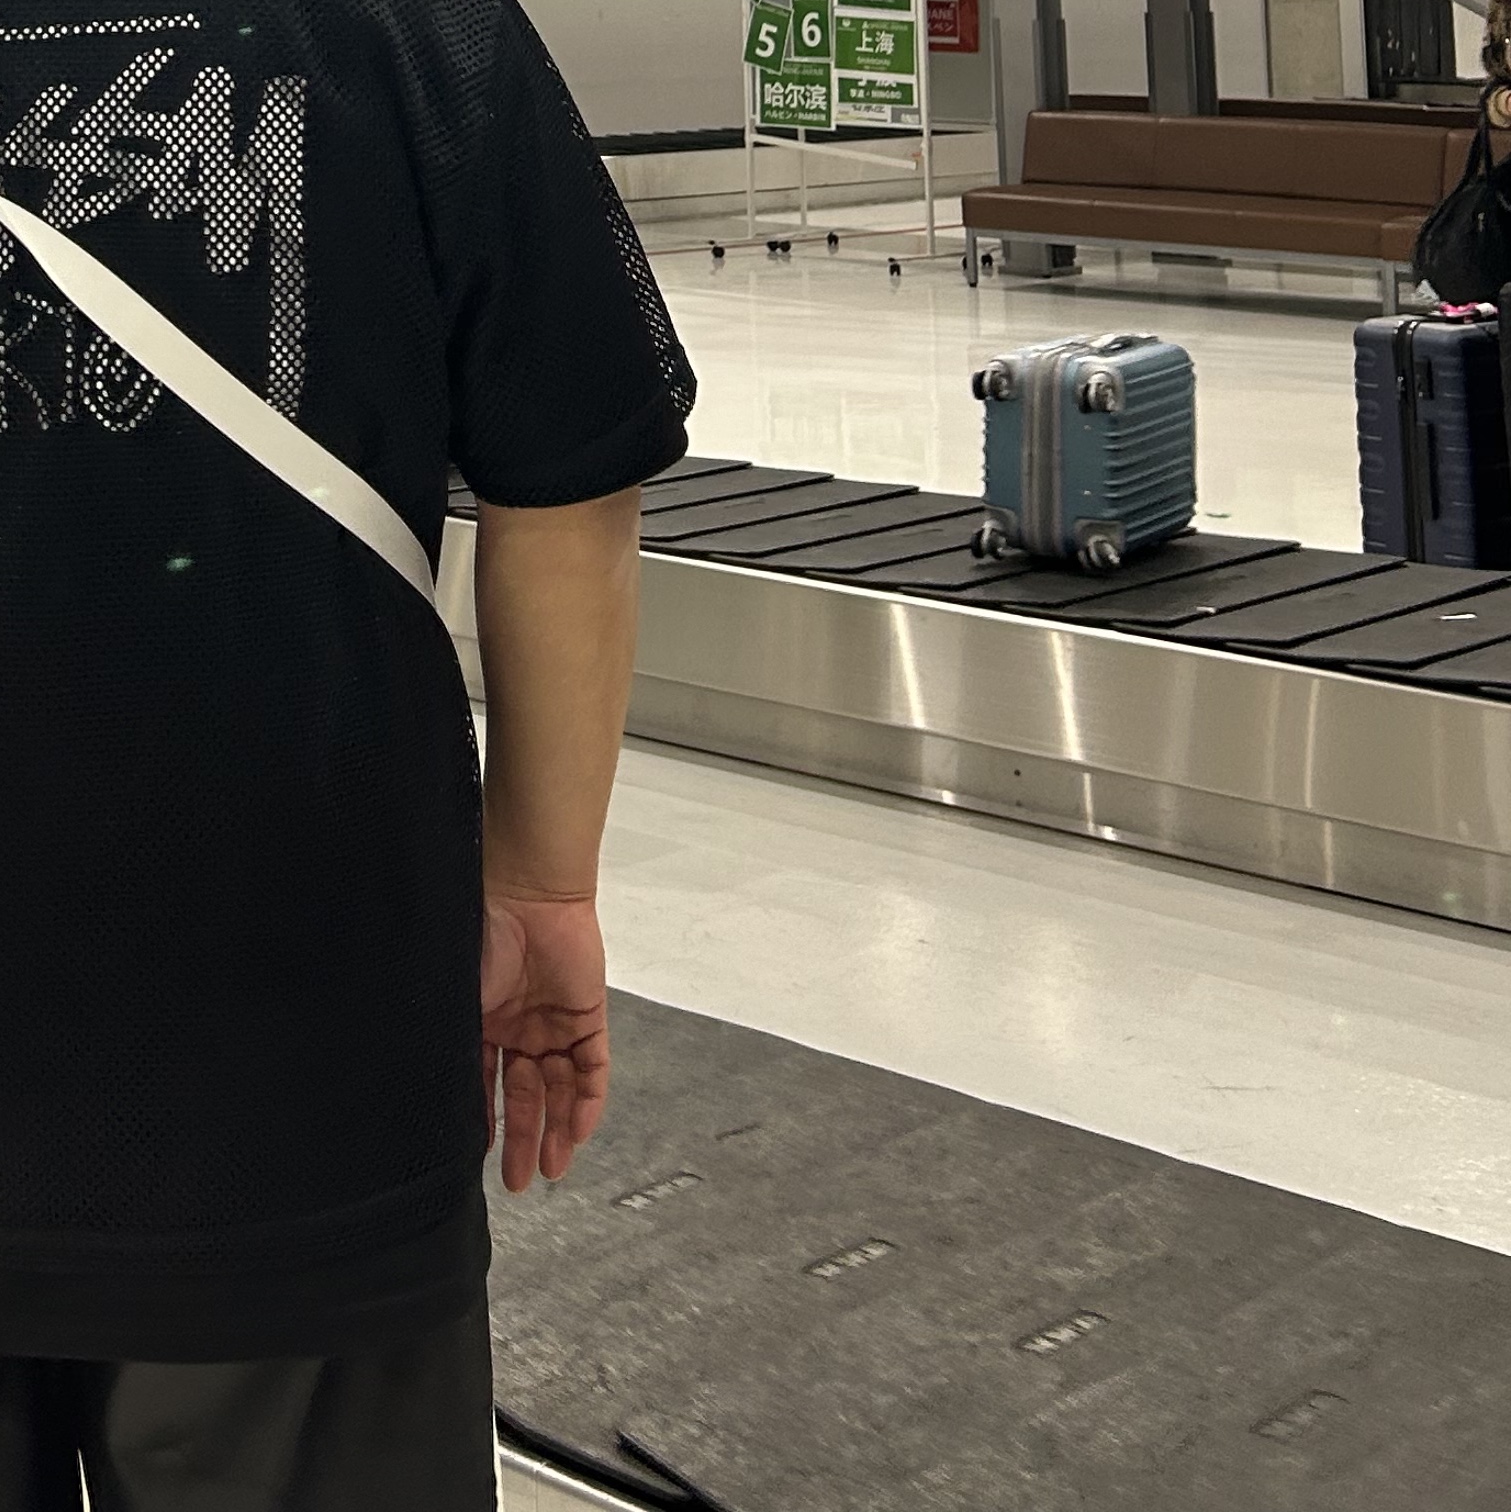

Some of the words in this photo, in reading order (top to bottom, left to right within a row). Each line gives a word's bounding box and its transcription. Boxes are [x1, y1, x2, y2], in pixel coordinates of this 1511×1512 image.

[755, 22, 778, 58] 5
[801, 12, 822, 48] 6
[855, 30, 895, 56] 上海
[764, 81, 827, 111] 哈尔滨
